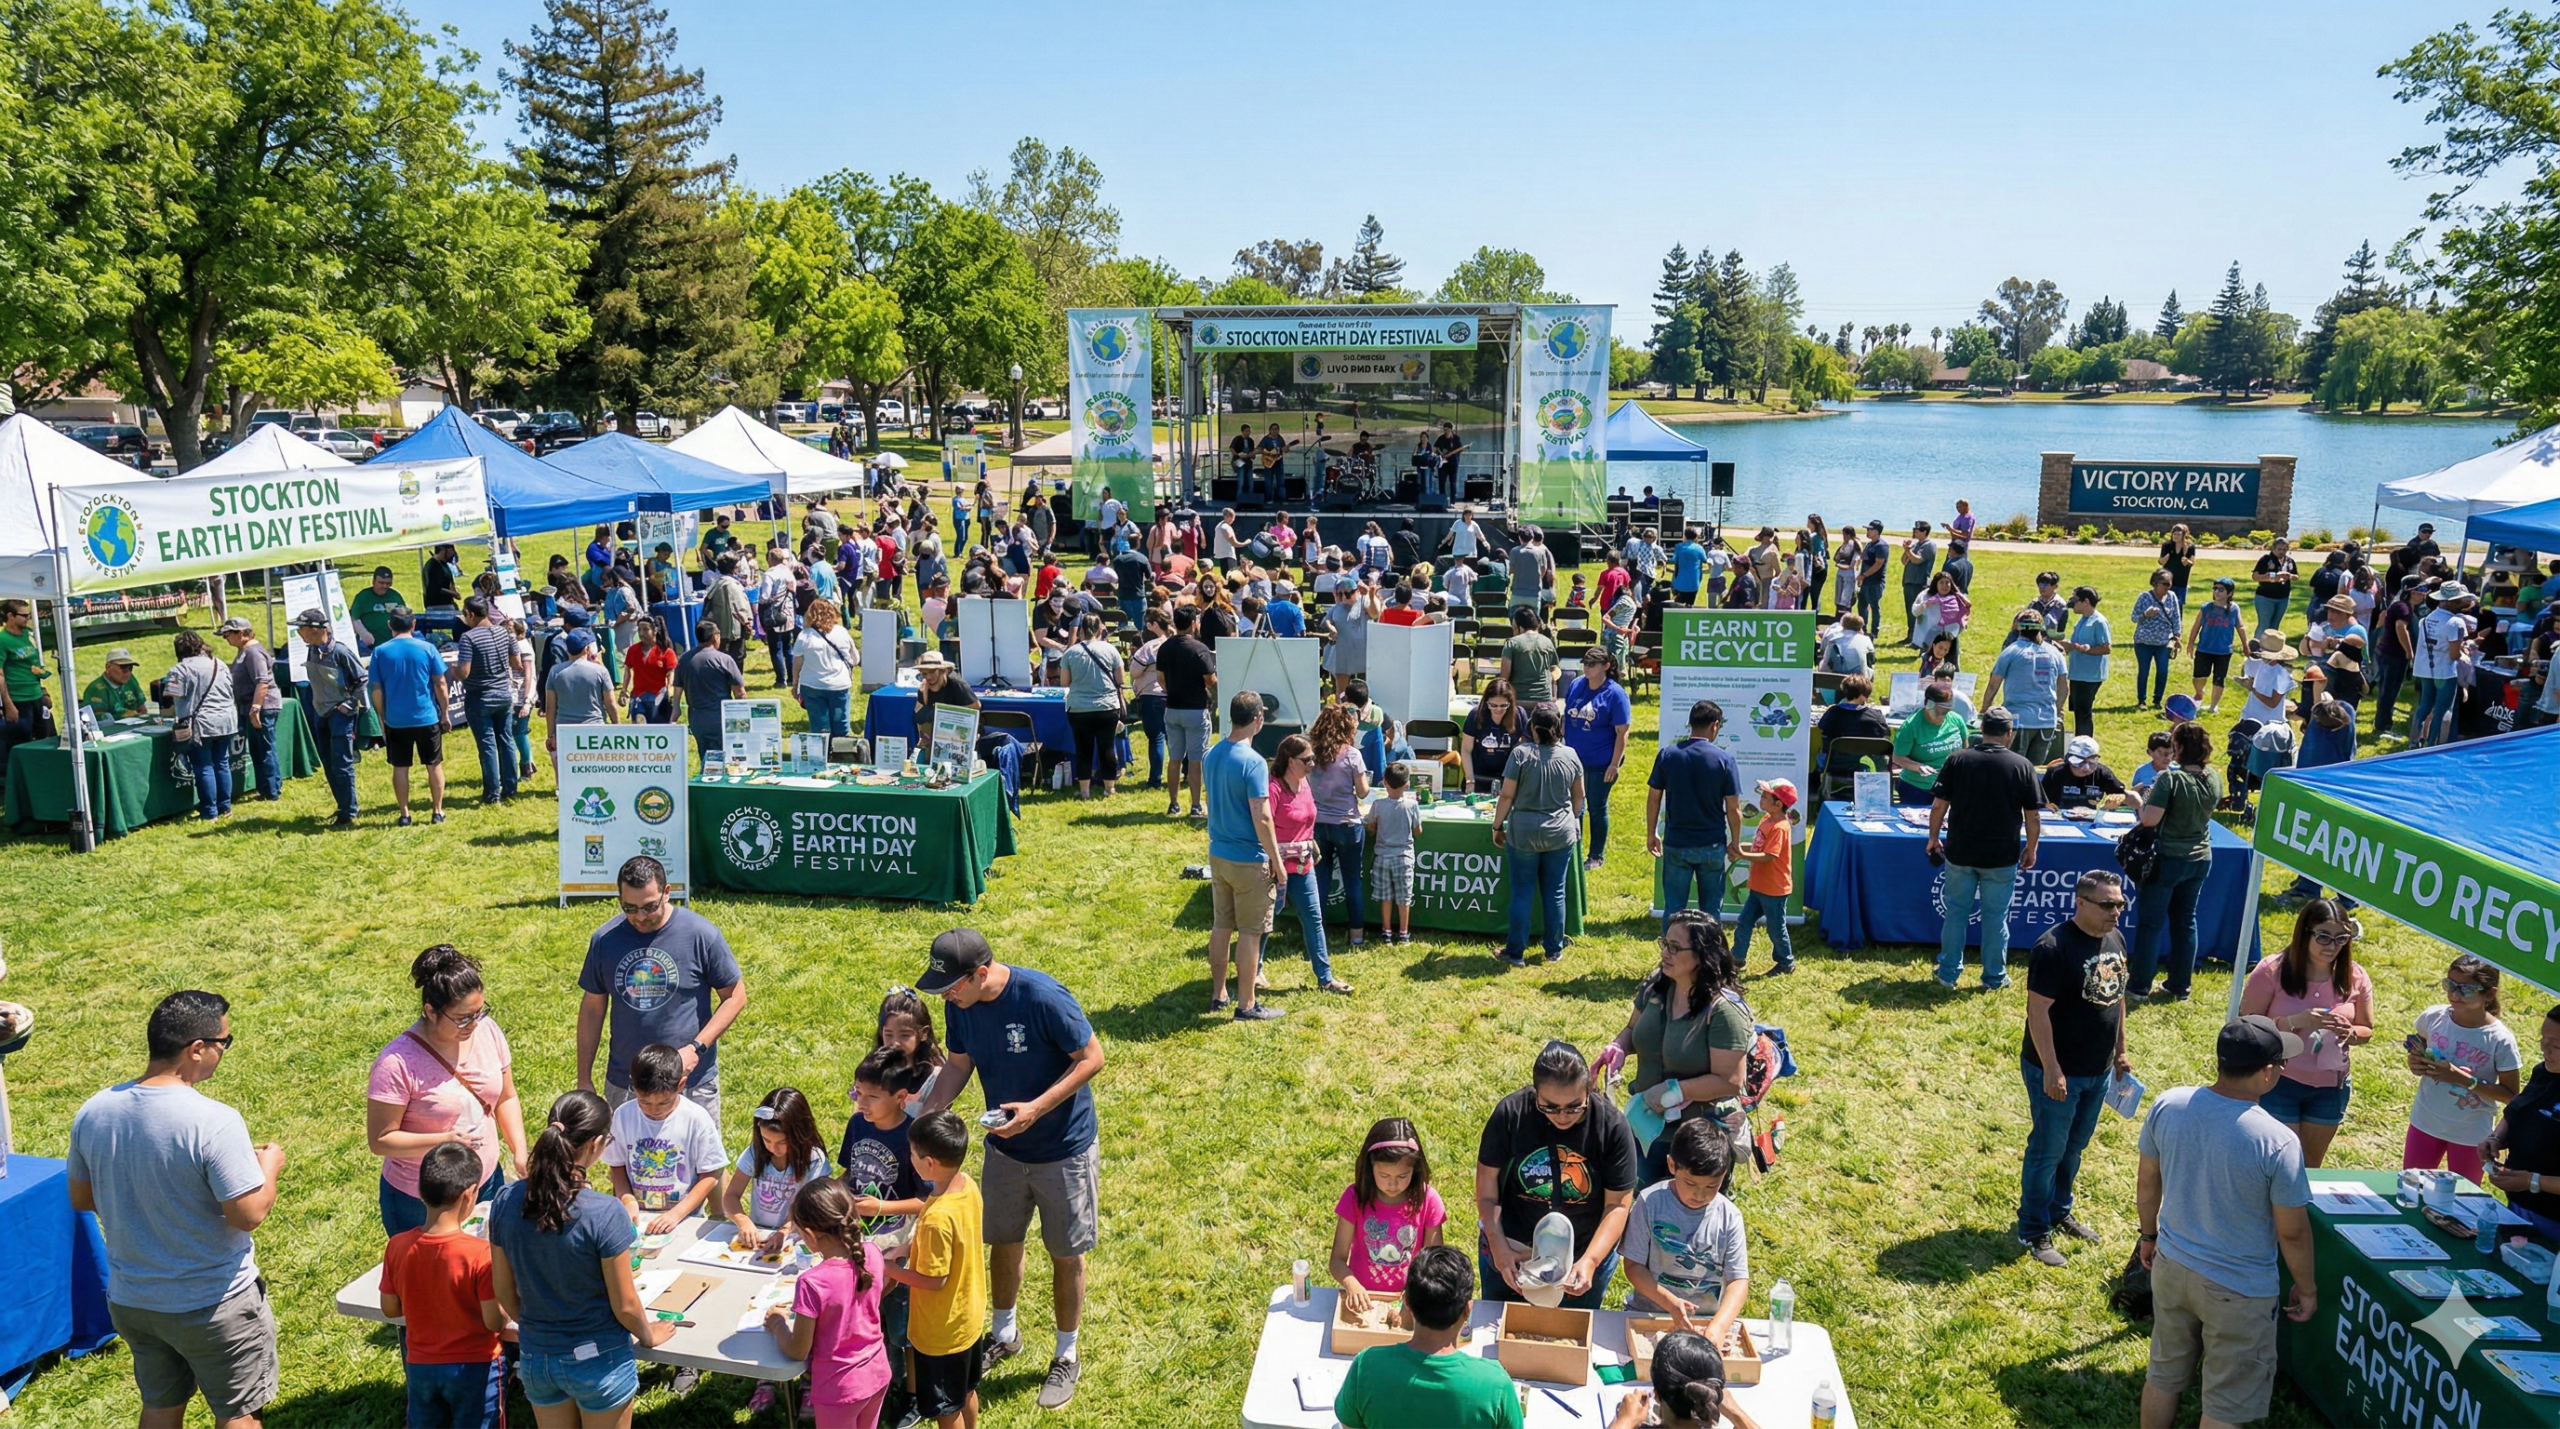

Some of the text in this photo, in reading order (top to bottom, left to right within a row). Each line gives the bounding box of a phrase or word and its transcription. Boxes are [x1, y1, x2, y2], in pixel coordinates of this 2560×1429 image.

[1226, 329, 1443, 346] STOCKTON EARTH DAY FESTIVAL
[2081, 469, 2247, 493] VICTORY PARK
[209, 477, 341, 517] STOCKTON
[2112, 495, 2209, 511] STOCKTON, CA
[157, 522, 243, 562] EARTH
[247, 516, 293, 551] DAY
[298, 507, 393, 544] FESTIVAL
[1685, 619, 1793, 639] LEARN TO
[1680, 640, 1798, 663] RECYCLE
[576, 735, 669, 750] LEARN TO
[791, 811, 917, 836] STOCKTON
[792, 834, 917, 857] EARTH DAY
[2273, 802, 2384, 884] LEARN
[2393, 848, 2443, 907] TO
[793, 855, 918, 875] FESTIVAL
[1416, 850, 1502, 874] CKTON
[1454, 875, 1501, 895] DAY
[1411, 894, 1499, 913] TIVAL
[2340, 1275, 2482, 1429] STOCKTON
[2335, 1313, 2425, 1429] EARTH
